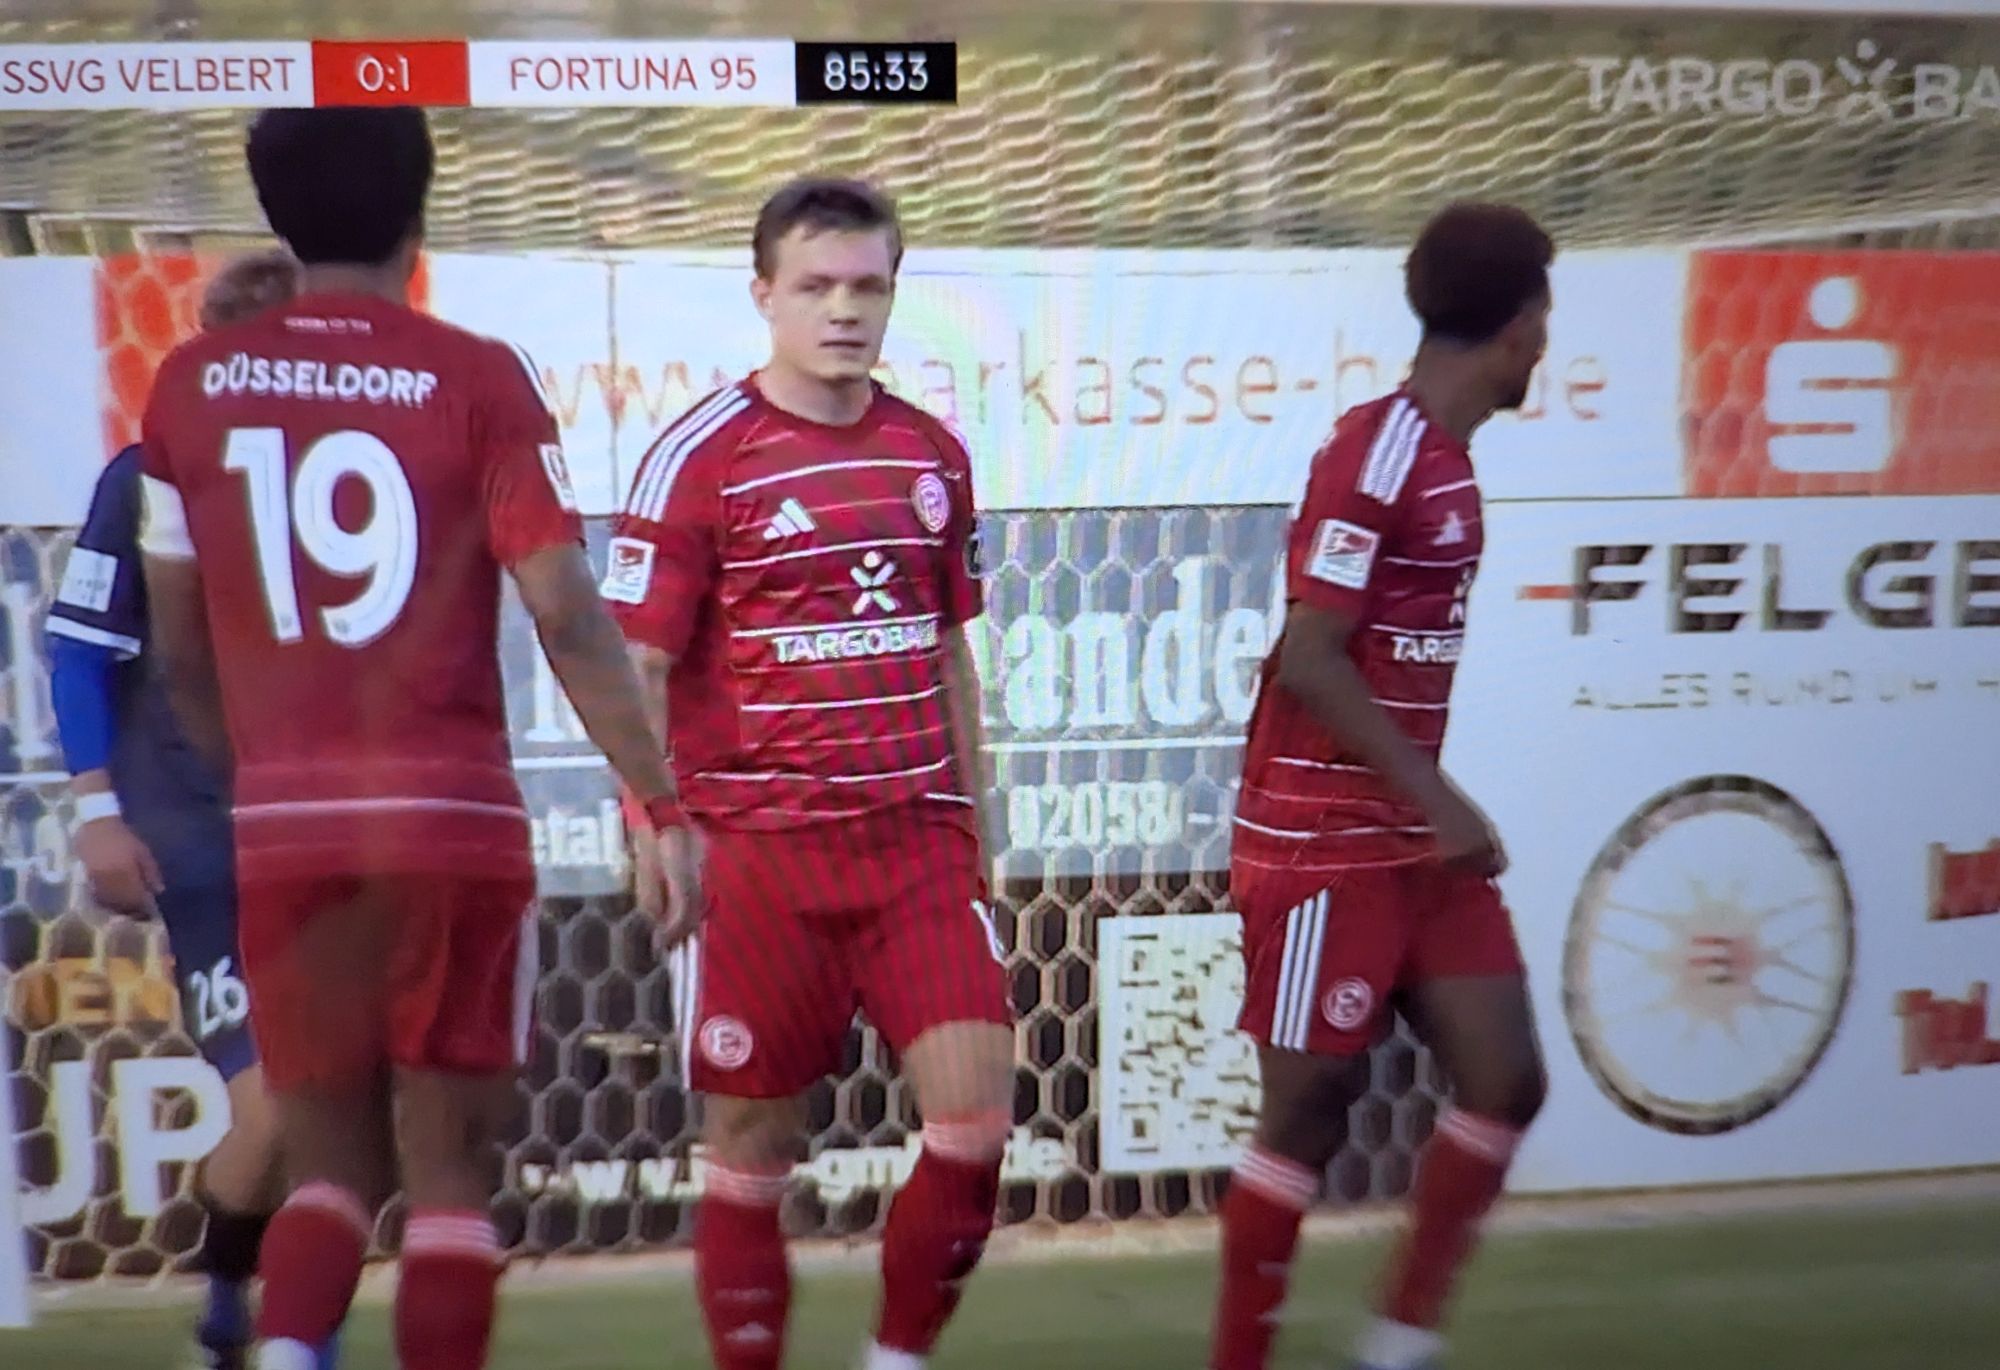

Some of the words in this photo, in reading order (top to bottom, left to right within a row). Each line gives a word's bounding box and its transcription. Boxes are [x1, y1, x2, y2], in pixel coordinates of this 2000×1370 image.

[3, 59, 105, 94] SSVG
[118, 57, 296, 93] VELBERT
[355, 54, 412, 93] 0:1
[509, 56, 699, 91] FORTUNA
[709, 57, 758, 91] 95
[823, 51, 930, 91] 85:33
[1577, 56, 1823, 117] TARGO
[203, 352, 438, 409] DÜSSELDORF
[222, 426, 419, 648] 19
[188, 955, 250, 1041] 26
